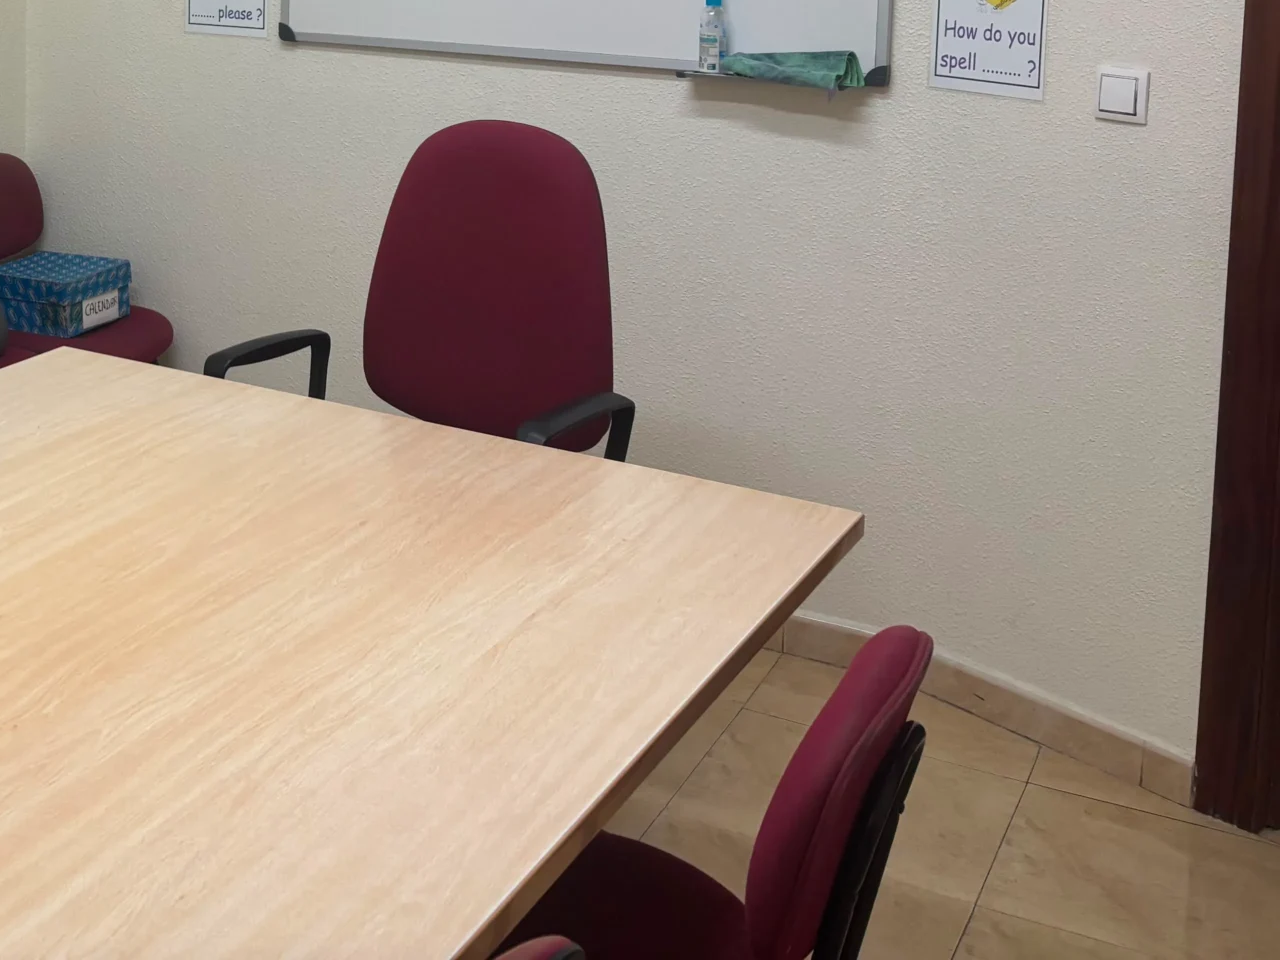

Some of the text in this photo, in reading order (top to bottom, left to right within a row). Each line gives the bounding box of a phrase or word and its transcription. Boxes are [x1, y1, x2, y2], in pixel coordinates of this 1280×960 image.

[218, 4, 254, 23] please
[943, 19, 1037, 50] How do you
[939, 51, 977, 74] spell
